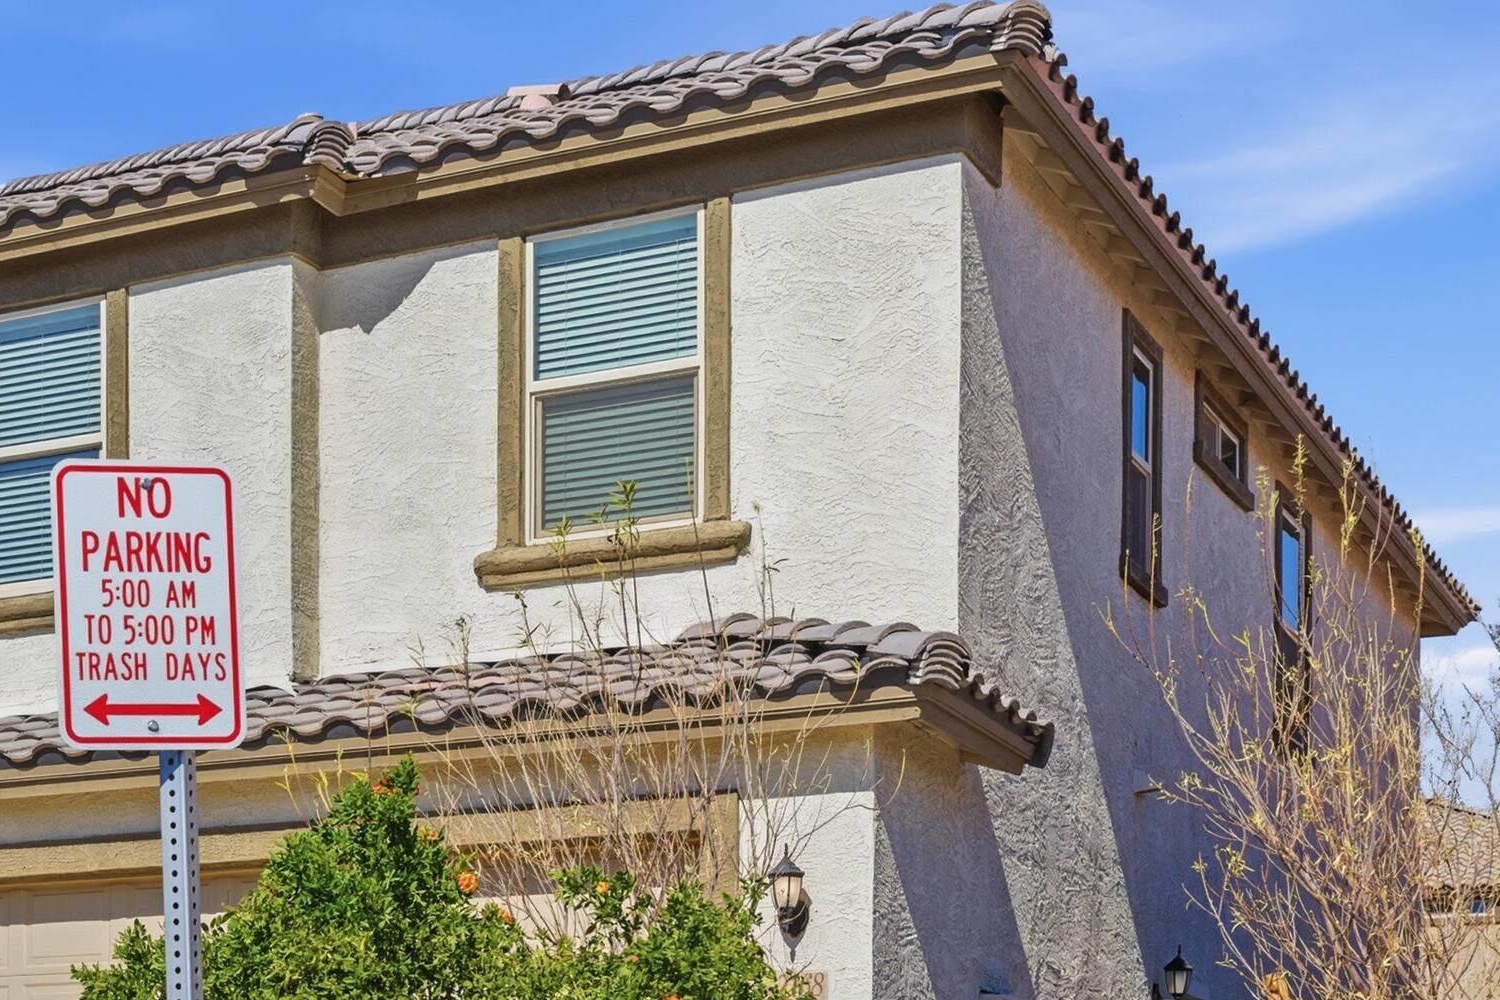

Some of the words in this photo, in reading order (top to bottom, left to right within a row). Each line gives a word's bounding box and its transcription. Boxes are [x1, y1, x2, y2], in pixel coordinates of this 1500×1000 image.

[116, 477, 172, 519] NO
[81, 530, 213, 574] PARKING
[101, 578, 151, 608] 5:00
[165, 580, 197, 609] AM
[83, 614, 113, 645] TO
[123, 614, 175, 645] 5:00
[185, 615, 217, 646] PM
[75, 652, 149, 682] TRASH
[165, 652, 228, 683] DAYS
